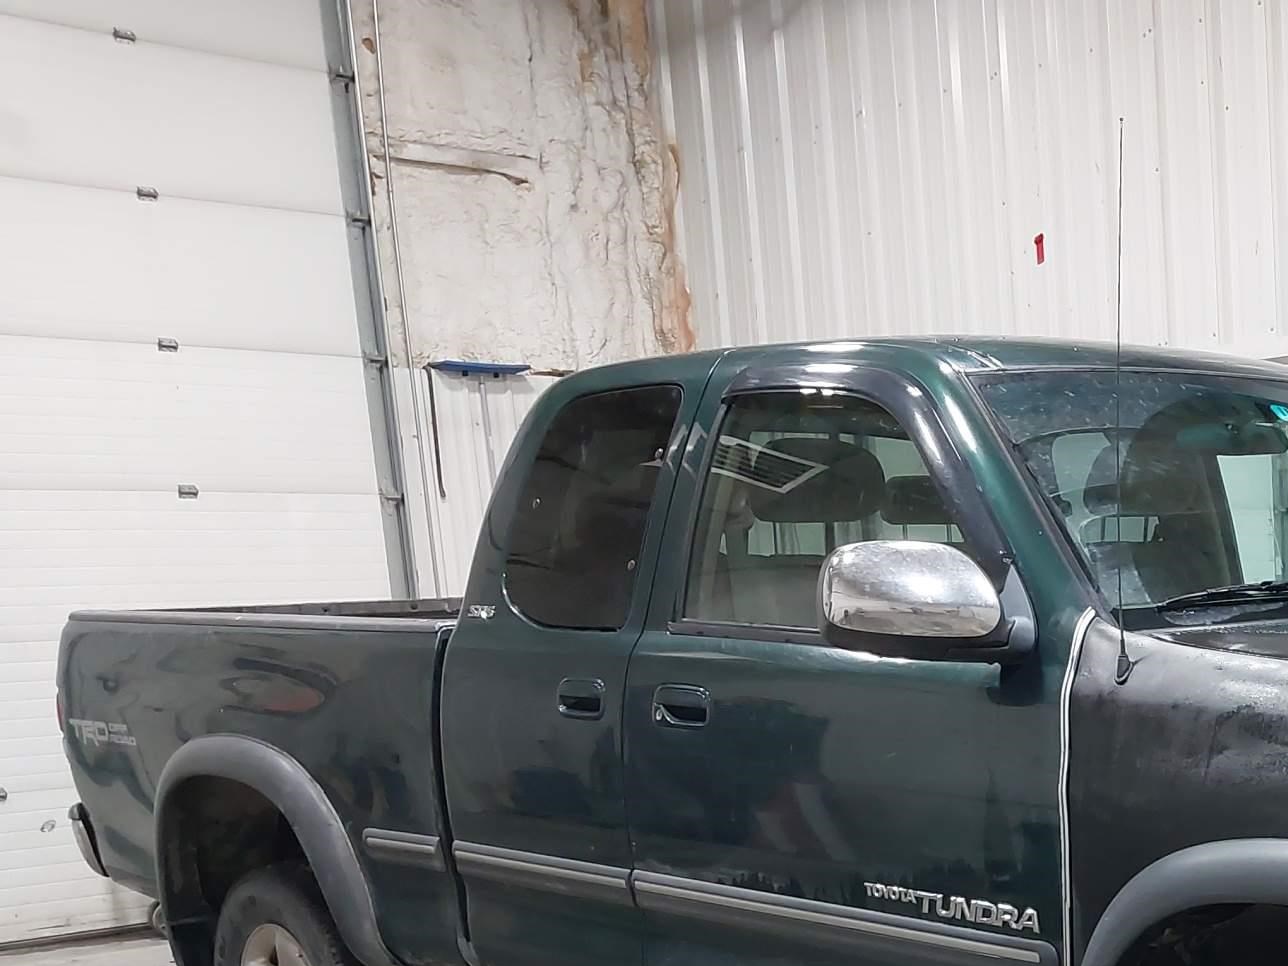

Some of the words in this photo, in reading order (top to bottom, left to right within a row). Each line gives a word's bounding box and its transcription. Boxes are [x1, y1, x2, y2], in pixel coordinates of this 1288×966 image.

[68, 718, 109, 747] TRD
[863, 882, 917, 904] TOYOTA
[915, 890, 1041, 934] TUNDRA
